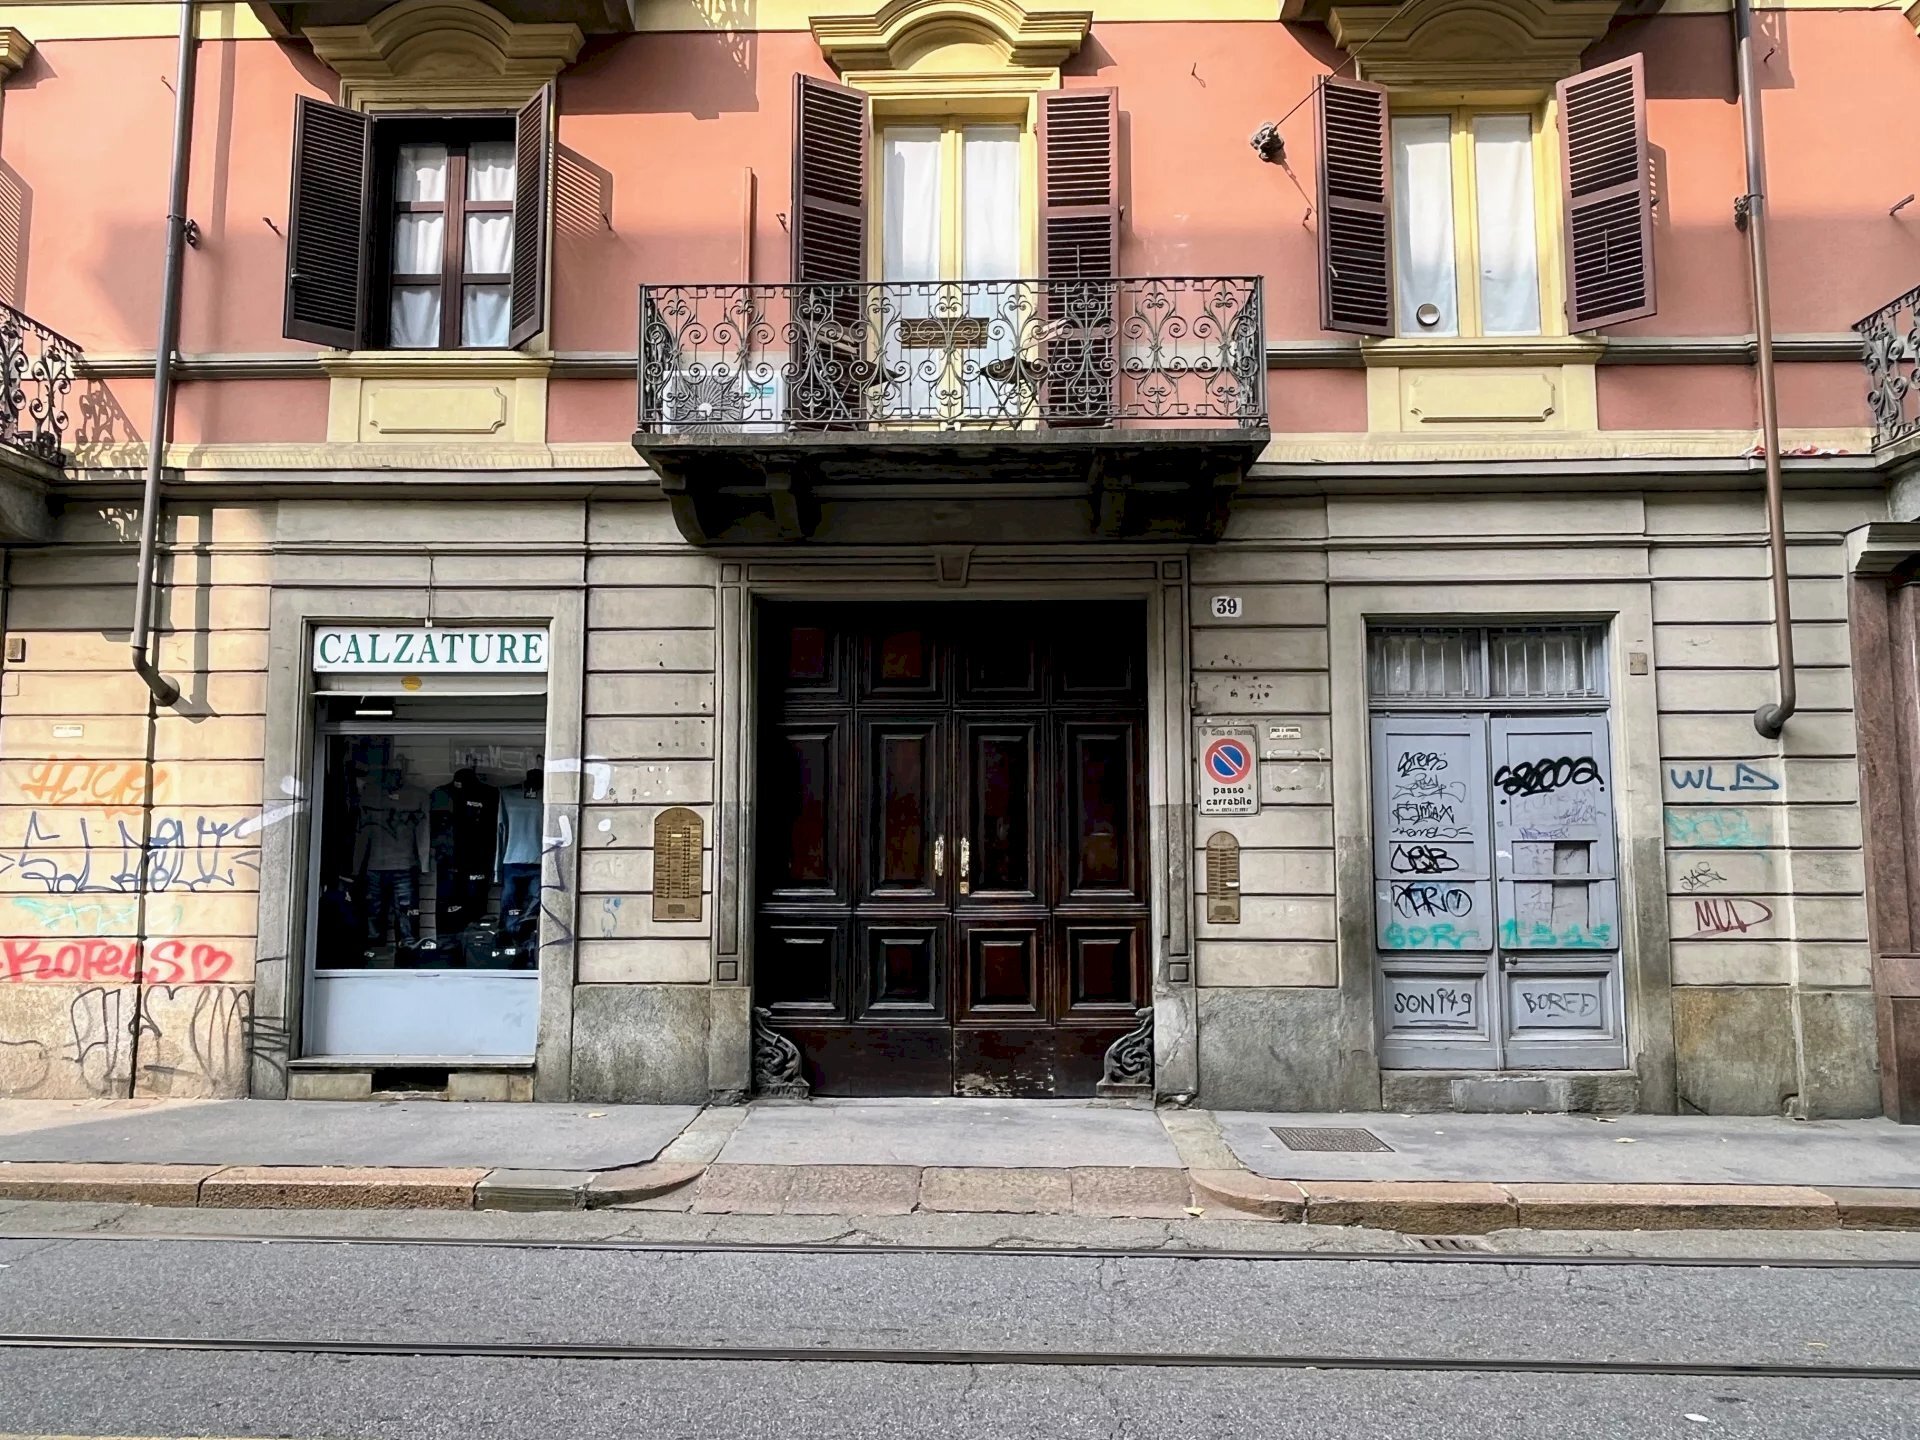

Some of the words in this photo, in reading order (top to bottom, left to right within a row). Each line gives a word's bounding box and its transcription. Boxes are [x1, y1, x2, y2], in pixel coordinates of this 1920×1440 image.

[1216, 597, 1238, 615] 39
[319, 633, 543, 664] CALZATURE
[1226, 728, 1233, 736] di
[1213, 787, 1244, 795] passo
[1206, 796, 1252, 806] carrabile
[1522, 992, 1598, 1018] BORED
